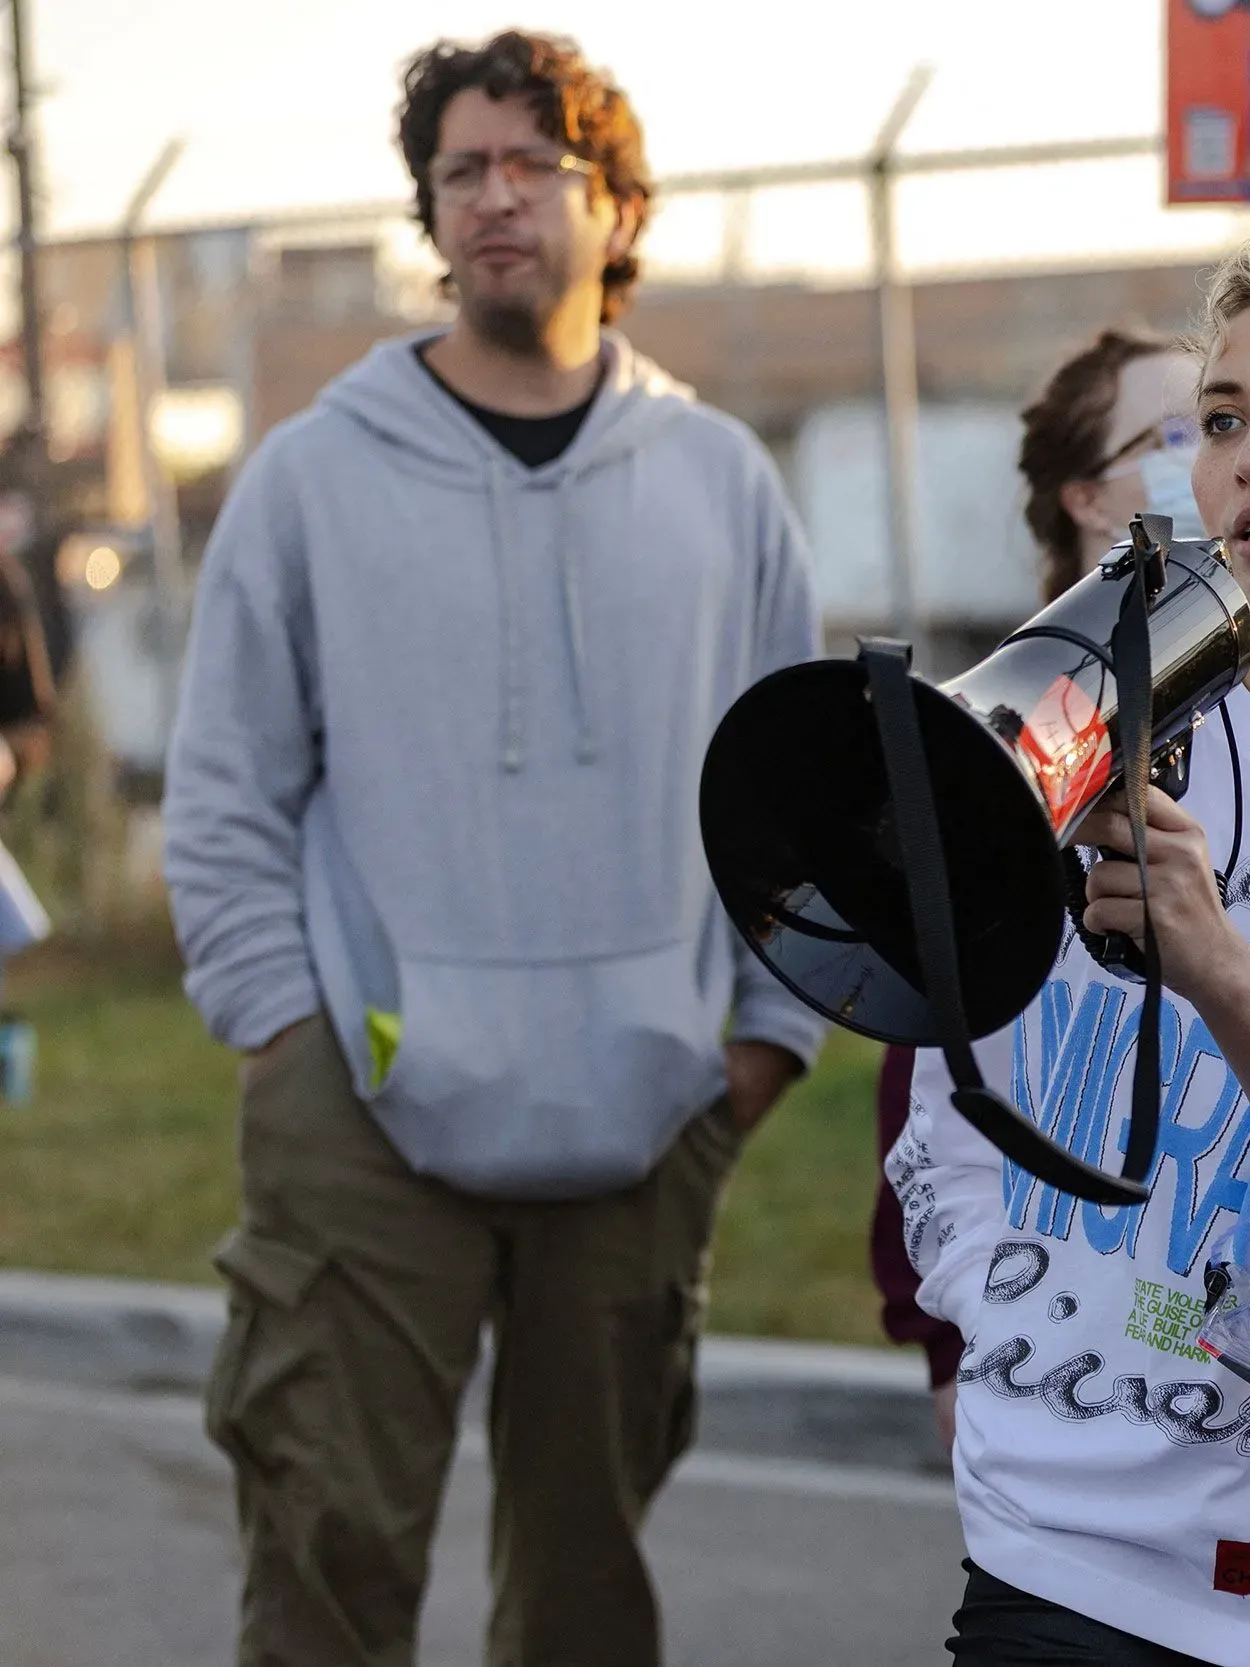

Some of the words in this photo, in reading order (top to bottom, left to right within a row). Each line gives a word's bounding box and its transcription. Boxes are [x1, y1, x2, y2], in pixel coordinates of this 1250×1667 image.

[1168, 1288, 1206, 1313] VIOLE
[1147, 1300, 1187, 1324] GUISE
[1190, 1314, 1206, 1329] O
[1152, 1318, 1192, 1341] BUILT
